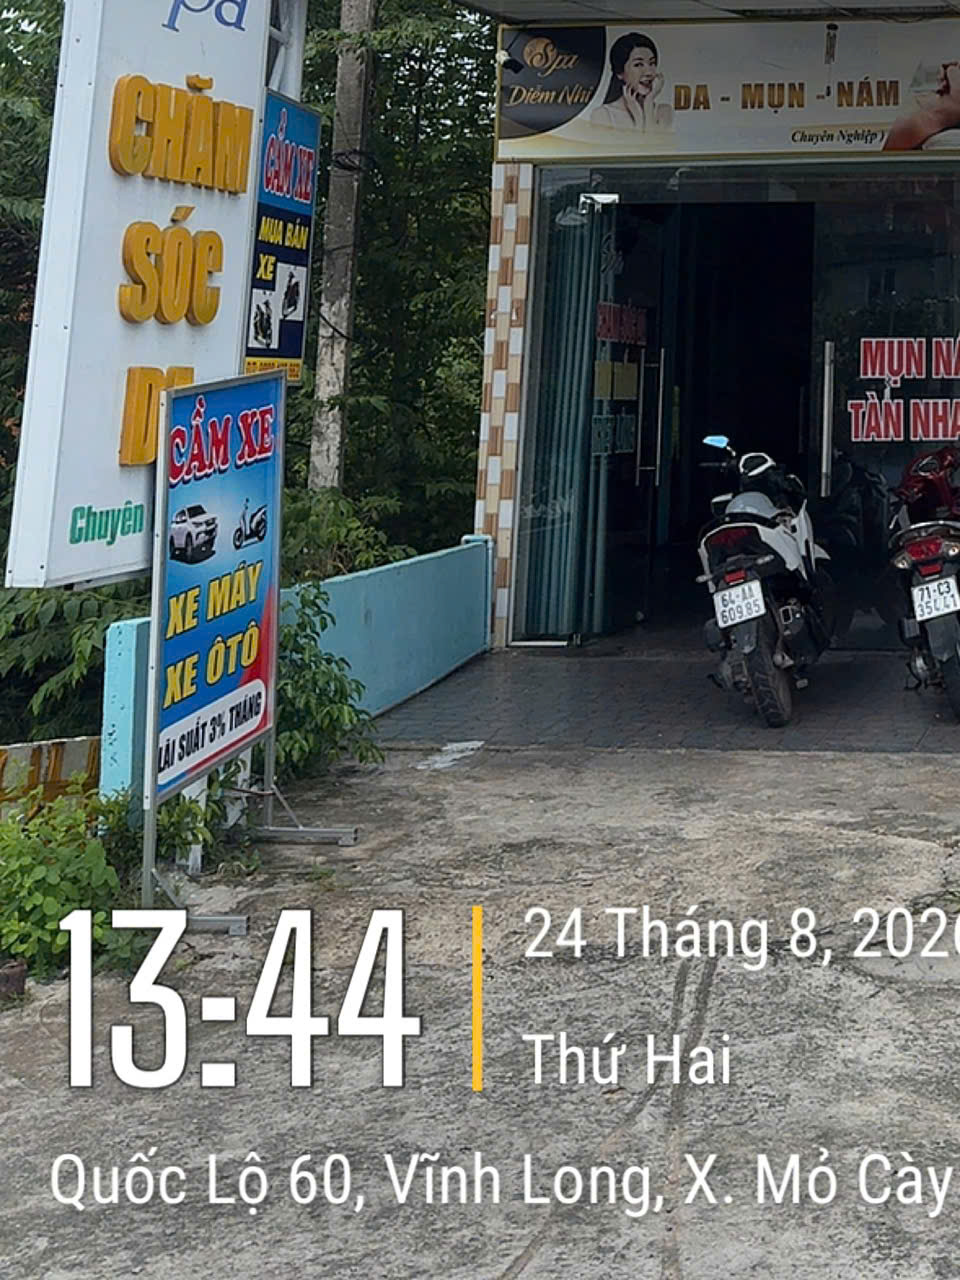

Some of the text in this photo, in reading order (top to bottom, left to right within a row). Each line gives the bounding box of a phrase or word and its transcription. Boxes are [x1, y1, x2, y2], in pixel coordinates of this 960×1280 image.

[529, 37, 579, 78] Spa
[674, 83, 711, 111] DA
[740, 80, 805, 115] MỤN
[836, 73, 900, 109] NÁM
[109, 73, 255, 197] CHĂM
[791, 129, 835, 146] Chuyên
[293, 144, 316, 204] XE
[258, 215, 284, 246] MUA
[118, 205, 224, 325] SÓC
[256, 253, 276, 281] XE
[860, 337, 926, 387] MỤN
[119, 365, 195, 467] D
[236, 404, 275, 468] XE
[69, 499, 145, 546] Chuyên
[166, 559, 263, 640] XE MÁY
[162, 623, 260, 711] XE ÔTÔ
[209, 710, 226, 744] 3%
[228, 690, 263, 732] THÁNG
